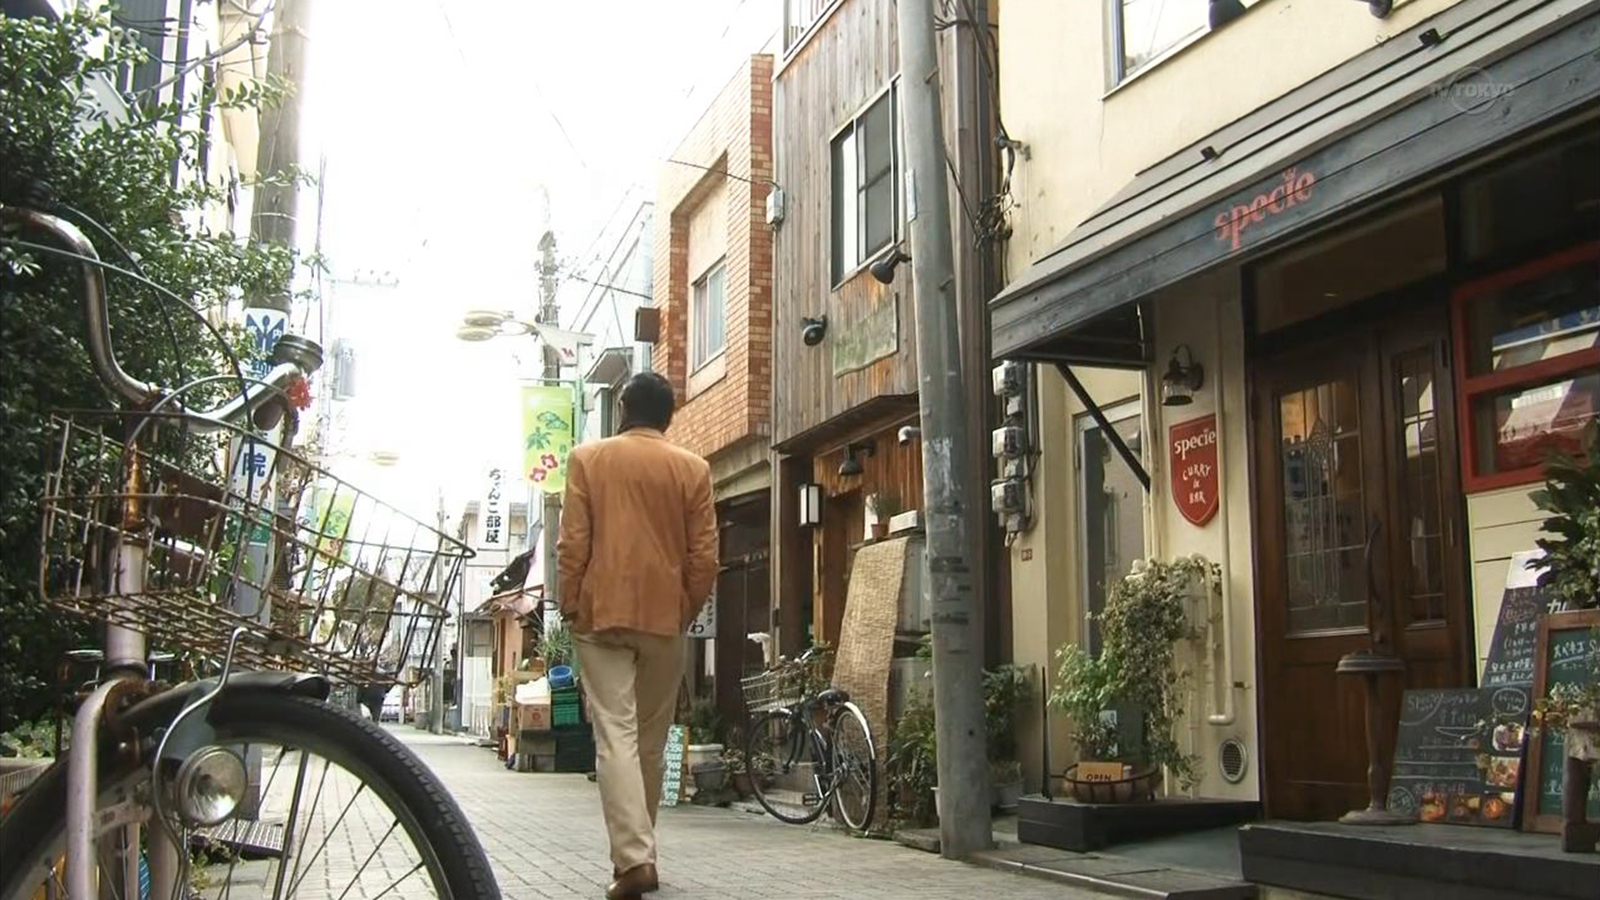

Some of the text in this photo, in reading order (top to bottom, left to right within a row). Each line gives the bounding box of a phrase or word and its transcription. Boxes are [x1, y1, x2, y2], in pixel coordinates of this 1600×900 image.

[1182, 463, 1211, 481] CURRY
[1189, 491, 1206, 504] BAR
[485, 468, 502, 544] ちゃんこ部屋
[1086, 773, 1112, 781] OPEN
